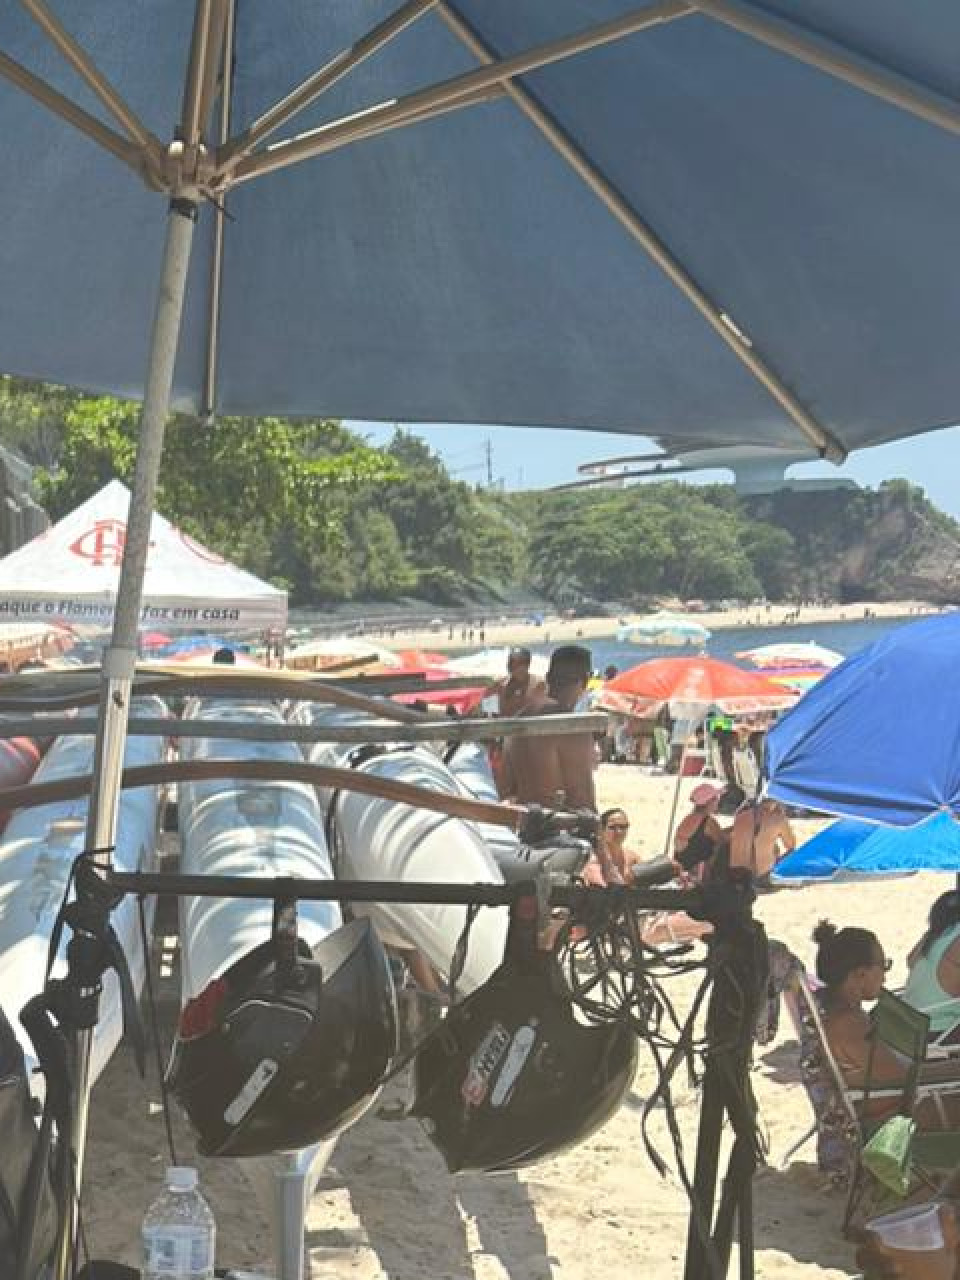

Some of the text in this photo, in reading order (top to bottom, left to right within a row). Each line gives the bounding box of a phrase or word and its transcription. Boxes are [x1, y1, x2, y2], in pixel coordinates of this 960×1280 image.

[141, 604, 169, 622] faz
[172, 607, 200, 619] em
[201, 607, 241, 620] casa
